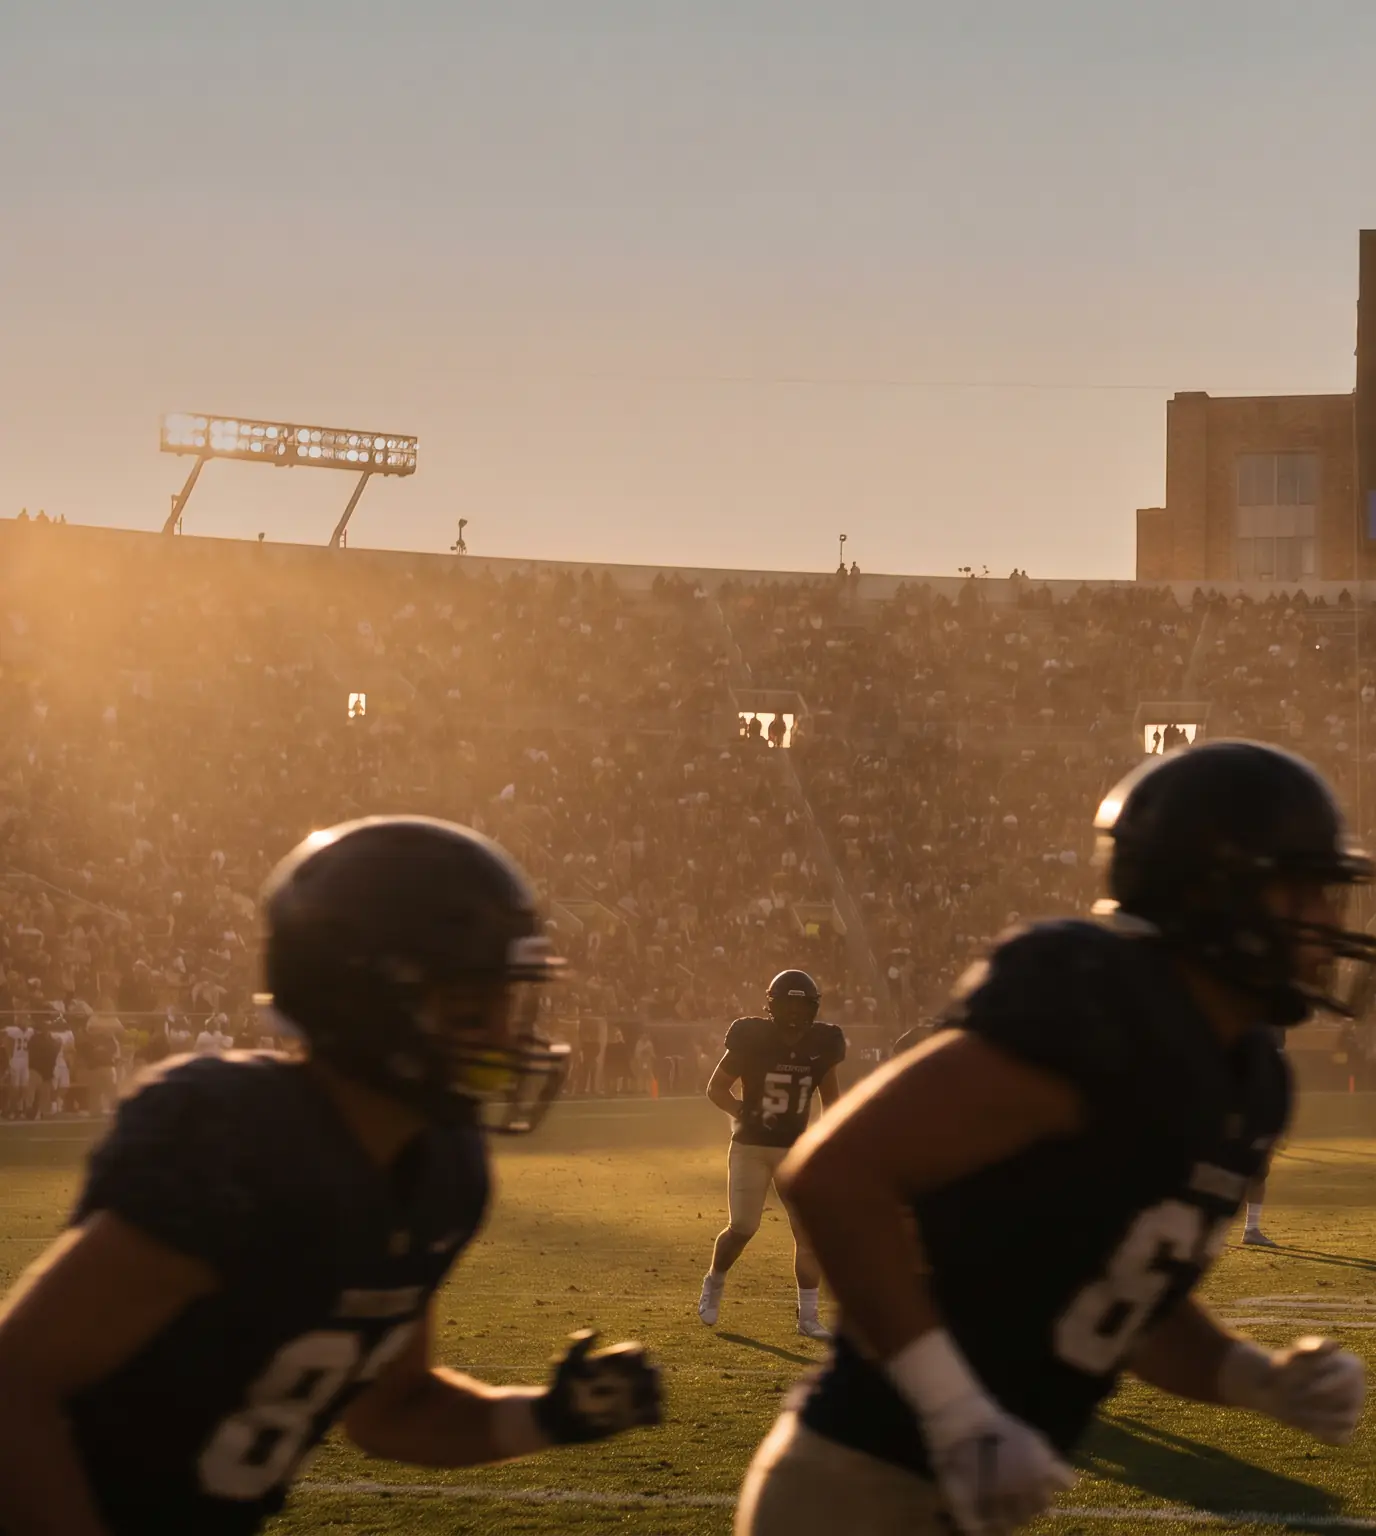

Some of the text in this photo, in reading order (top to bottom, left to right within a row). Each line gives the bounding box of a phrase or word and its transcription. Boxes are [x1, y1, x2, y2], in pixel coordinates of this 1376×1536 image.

[762, 1072, 813, 1114] 51
[1053, 1199, 1232, 1376] 6
[199, 1322, 412, 1499] 8
